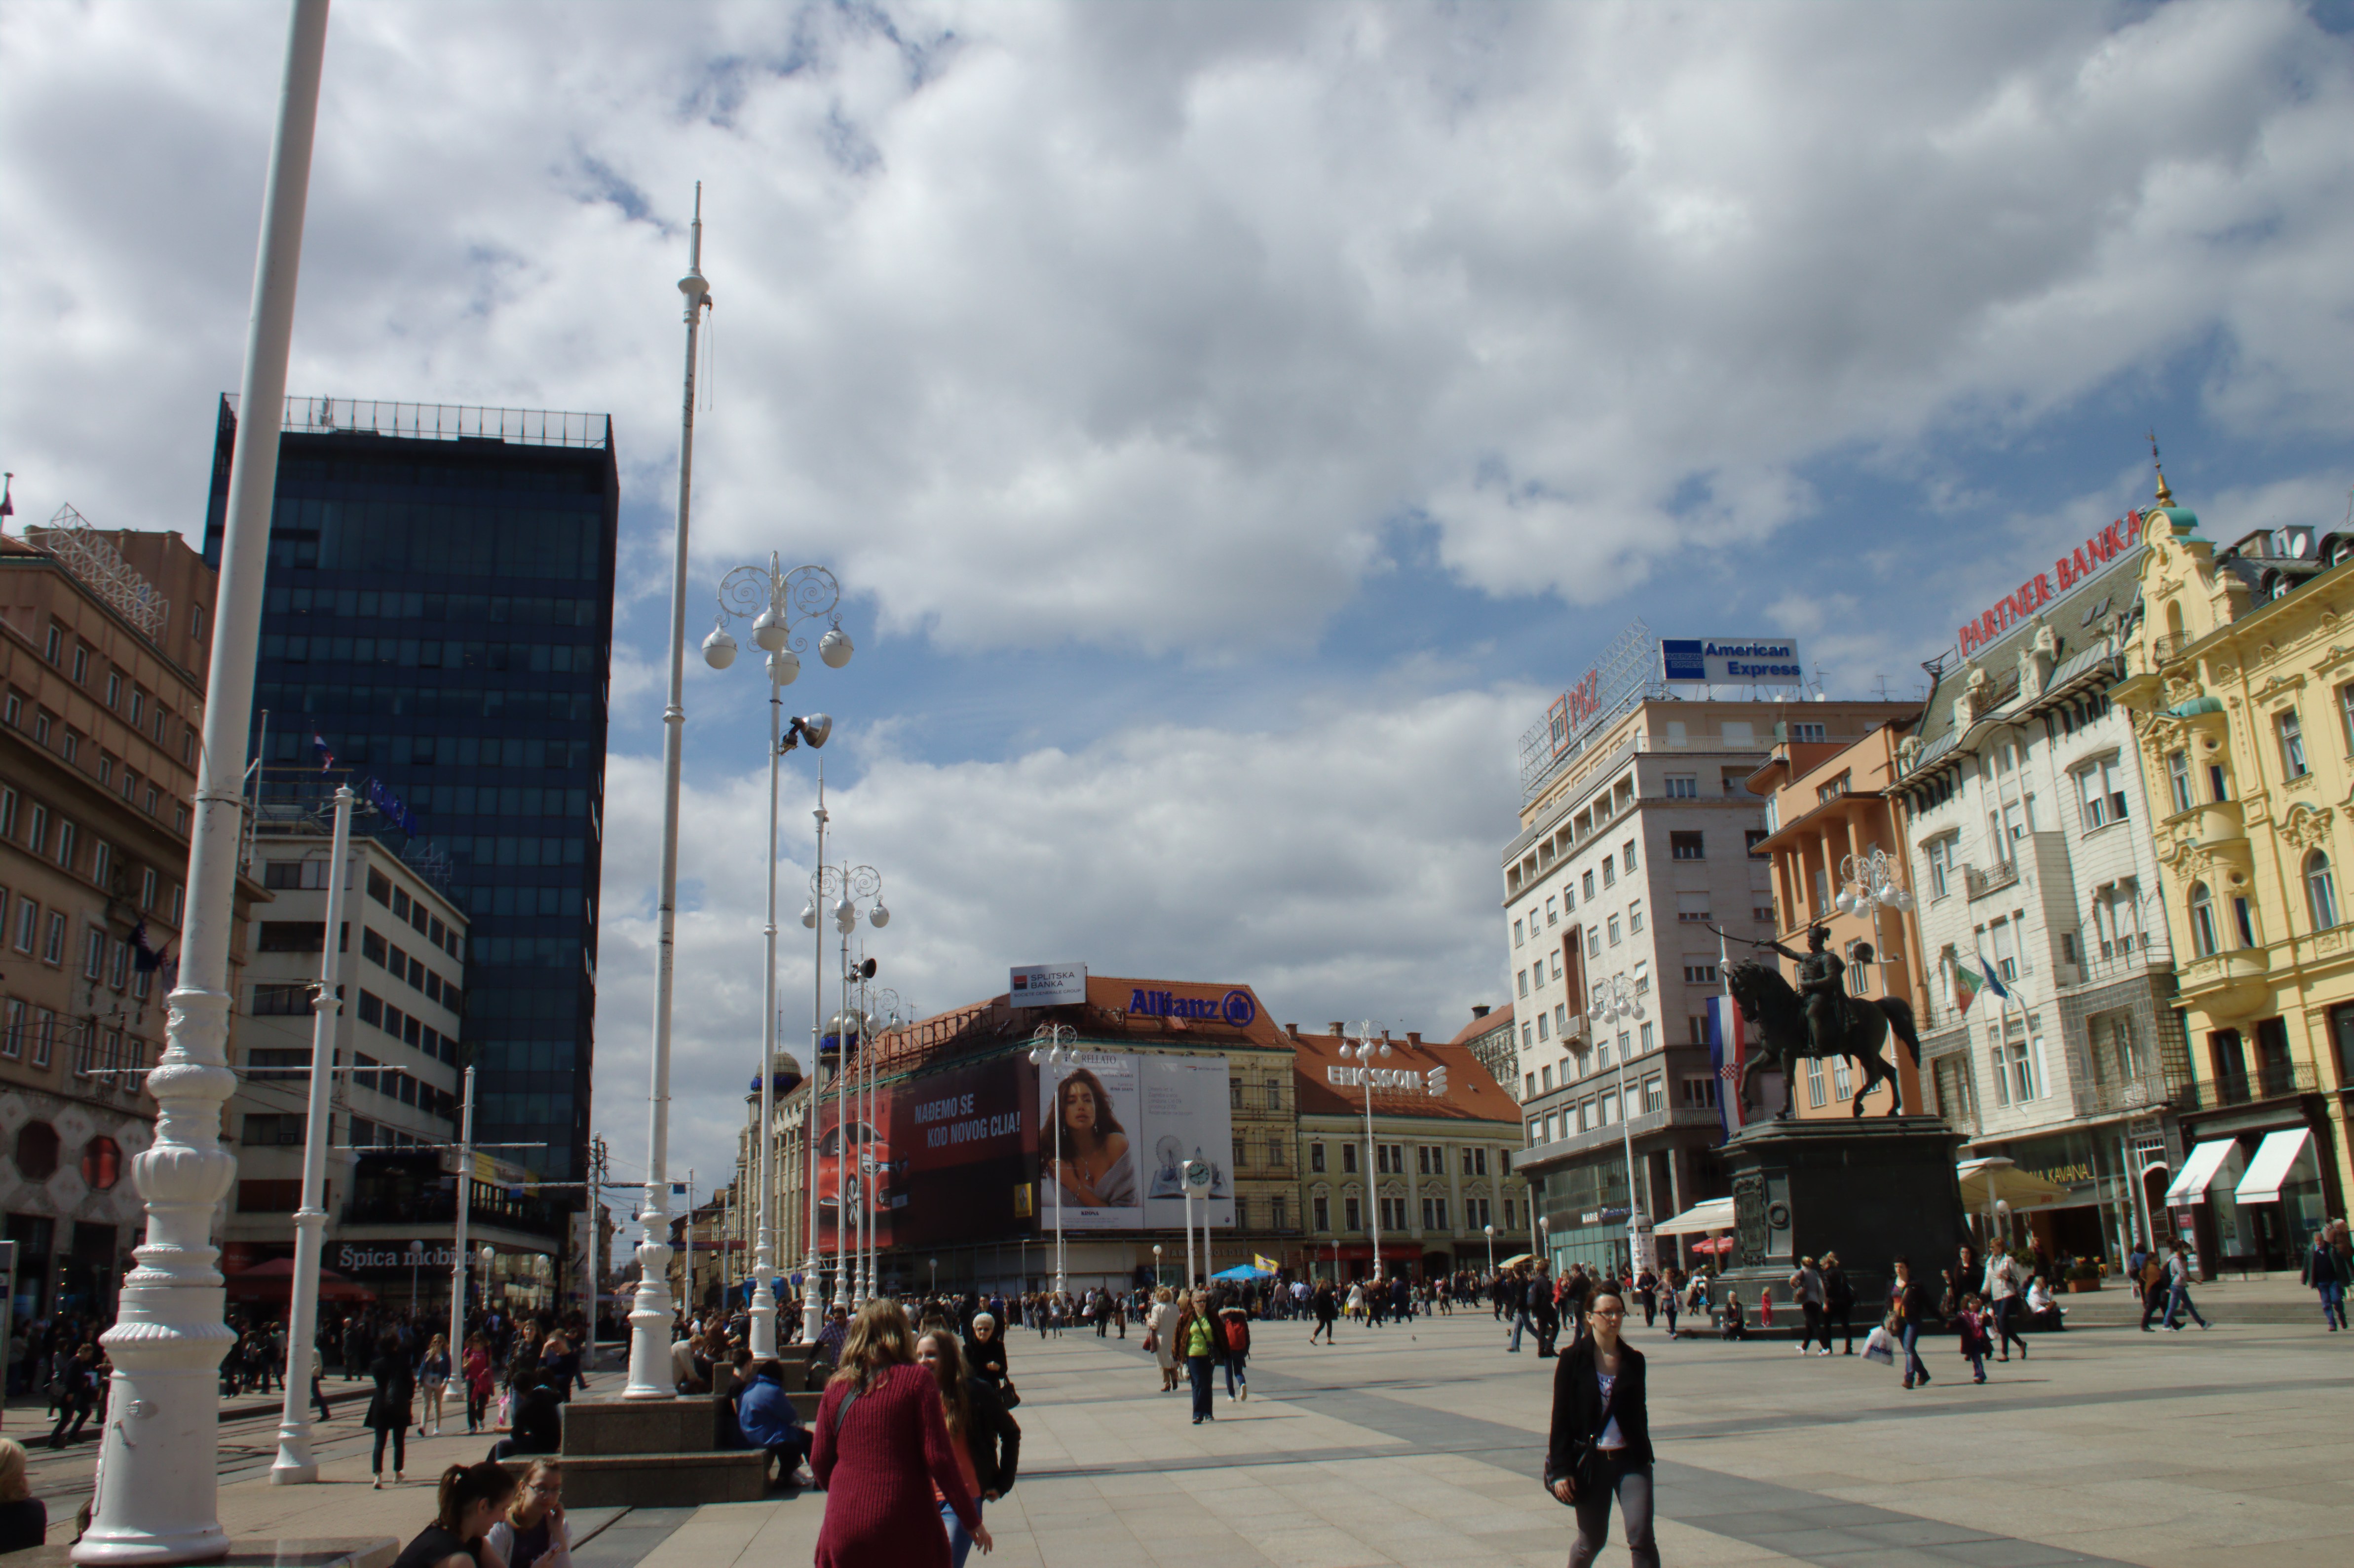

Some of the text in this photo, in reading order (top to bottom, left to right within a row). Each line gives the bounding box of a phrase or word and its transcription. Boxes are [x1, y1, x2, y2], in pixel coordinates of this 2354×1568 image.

[1959, 509, 2142, 657] PARTNER BANKA
[1705, 642, 1790, 657] American
[1727, 661, 1801, 677] Express
[1568, 669, 1600, 732] PBZ
[1031, 971, 1075, 981] SPLITSKA
[1031, 980, 1063, 989] BANKA
[1128, 988, 1219, 1019] Allianz
[1328, 1066, 1421, 1089] ERICSSON
[915, 1093, 974, 1124] NAĐEMO SE
[927, 1111, 1021, 1148] KOD NOVOG CLIA!
[2048, 1163, 2089, 1184] KAVANA
[1582, 1212, 1598, 1224] MARIS
[340, 1244, 398, 1271] Špica
